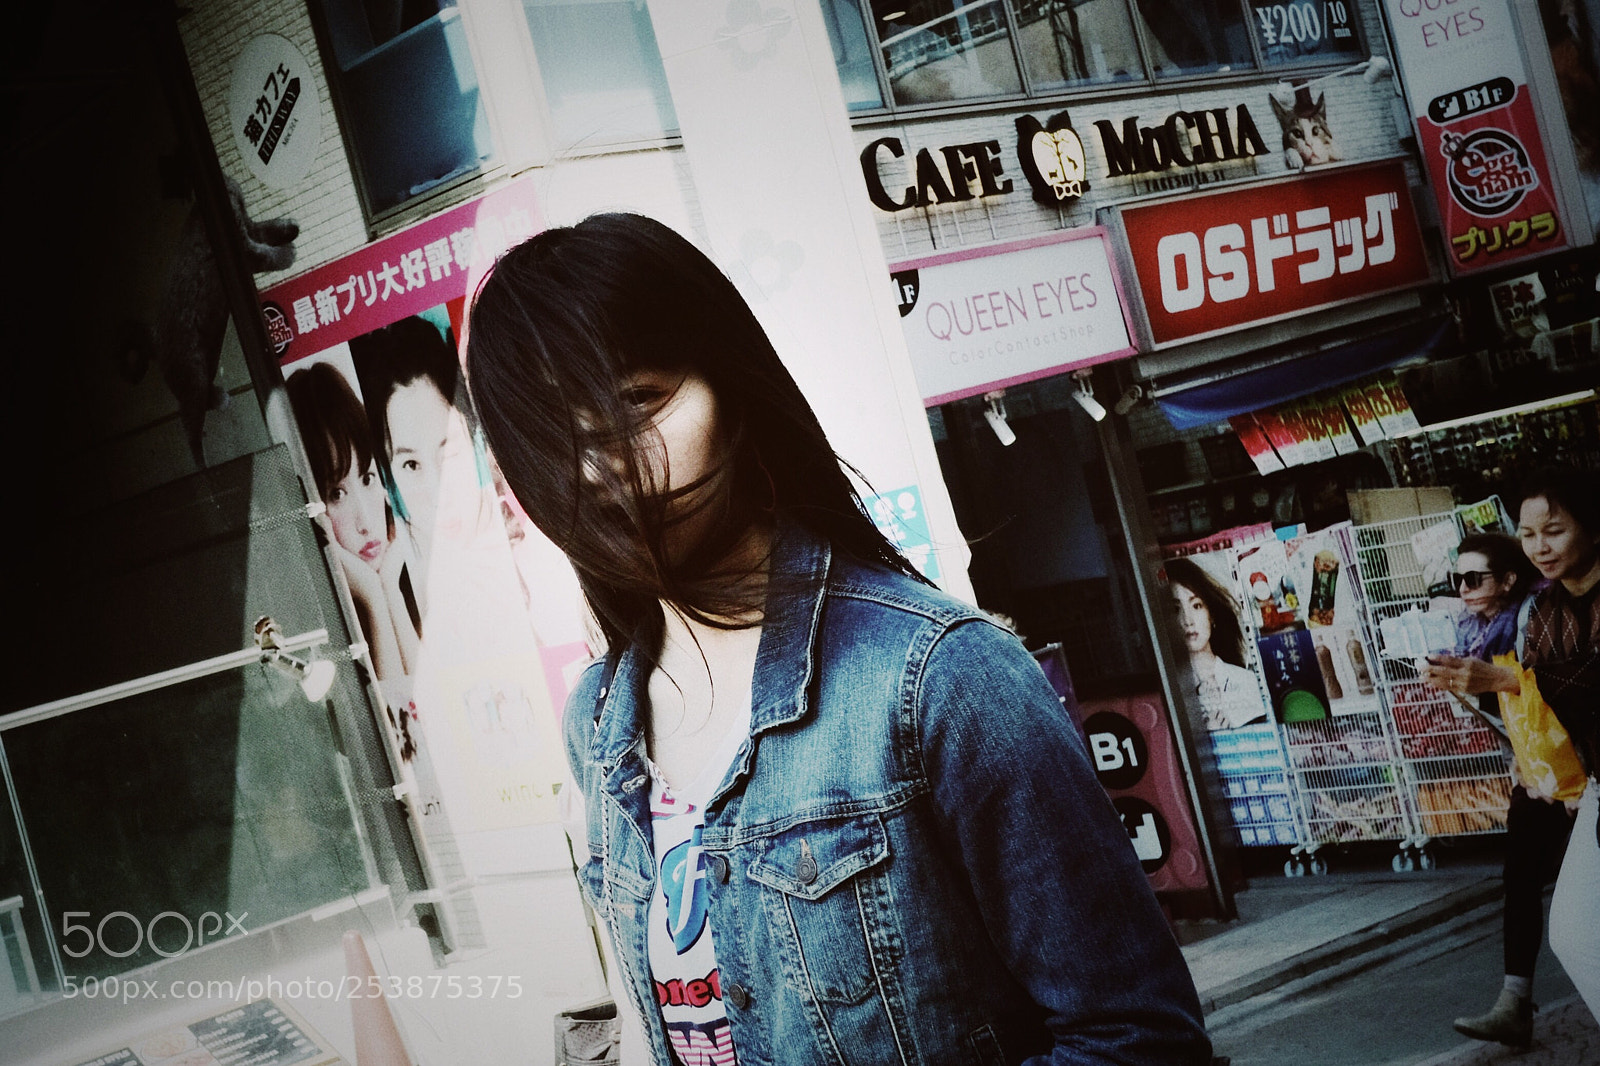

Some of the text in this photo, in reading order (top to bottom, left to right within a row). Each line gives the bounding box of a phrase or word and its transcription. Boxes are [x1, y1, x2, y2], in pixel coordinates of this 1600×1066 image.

[1421, 6, 1485, 48] EYES
[243, 63, 290, 147] 猫カフェ
[1463, 85, 1503, 112] B1F
[860, 137, 1014, 212] CAFE
[1157, 192, 1399, 314] OSドラッグ
[925, 273, 1098, 341] QUEEN EYES
[1089, 732, 1139, 772] B1
